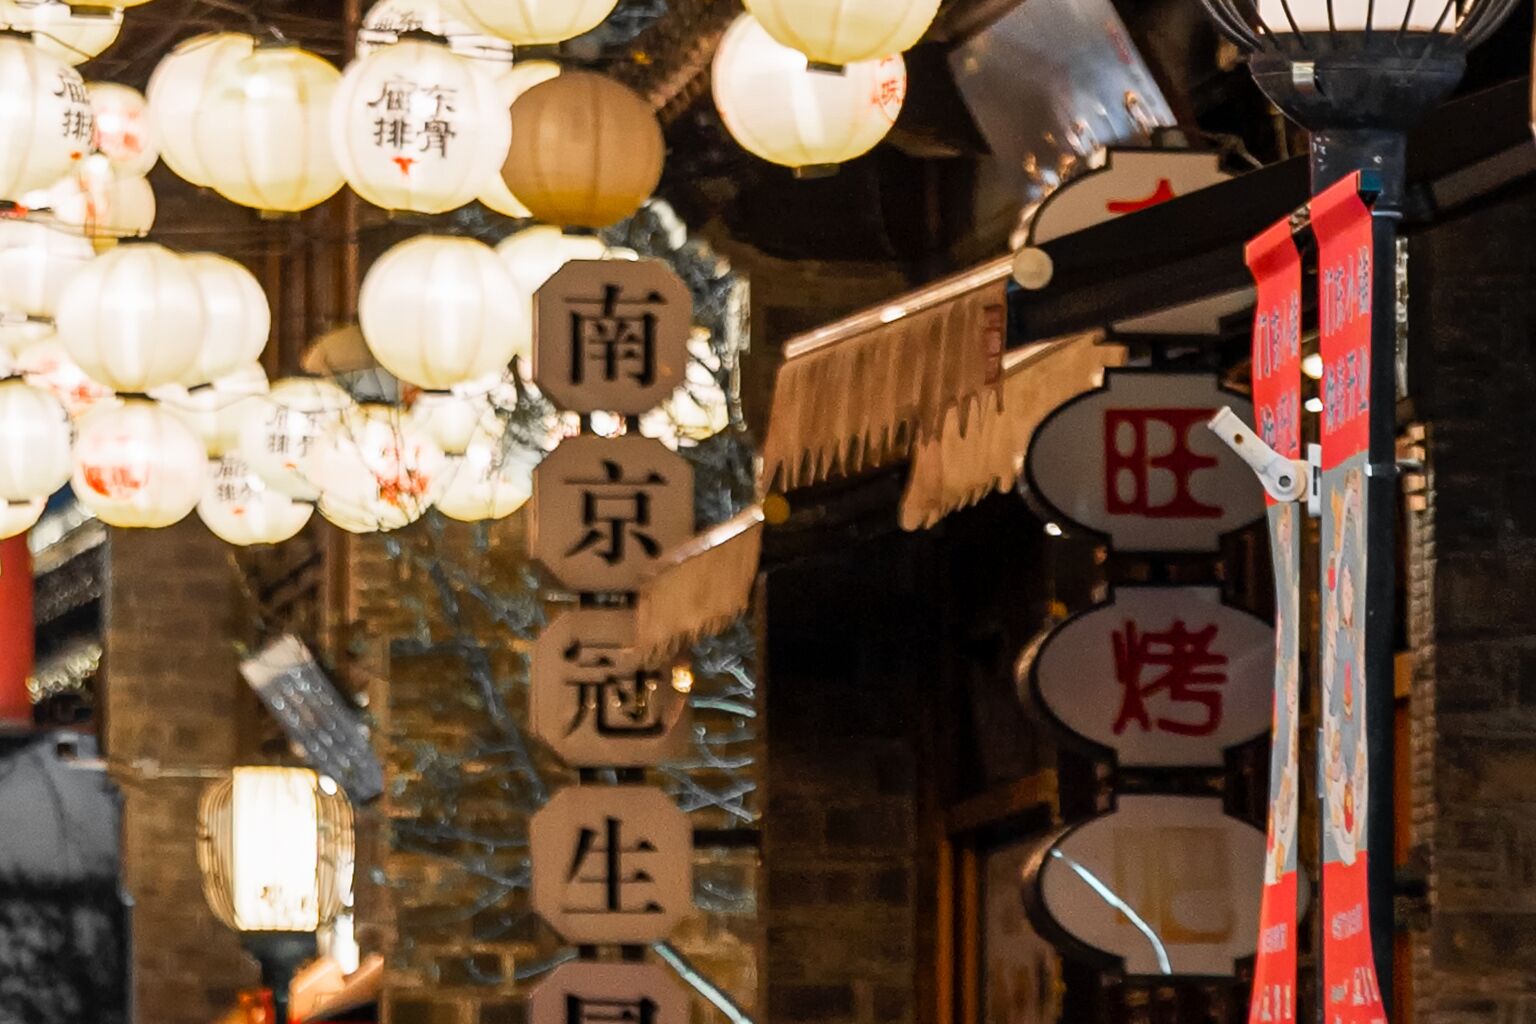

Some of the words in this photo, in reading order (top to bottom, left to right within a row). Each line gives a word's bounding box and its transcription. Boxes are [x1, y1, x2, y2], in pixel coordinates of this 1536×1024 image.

[373, 117, 457, 160] 排骨
[1106, 179, 1235, 944] 旺烤吧
